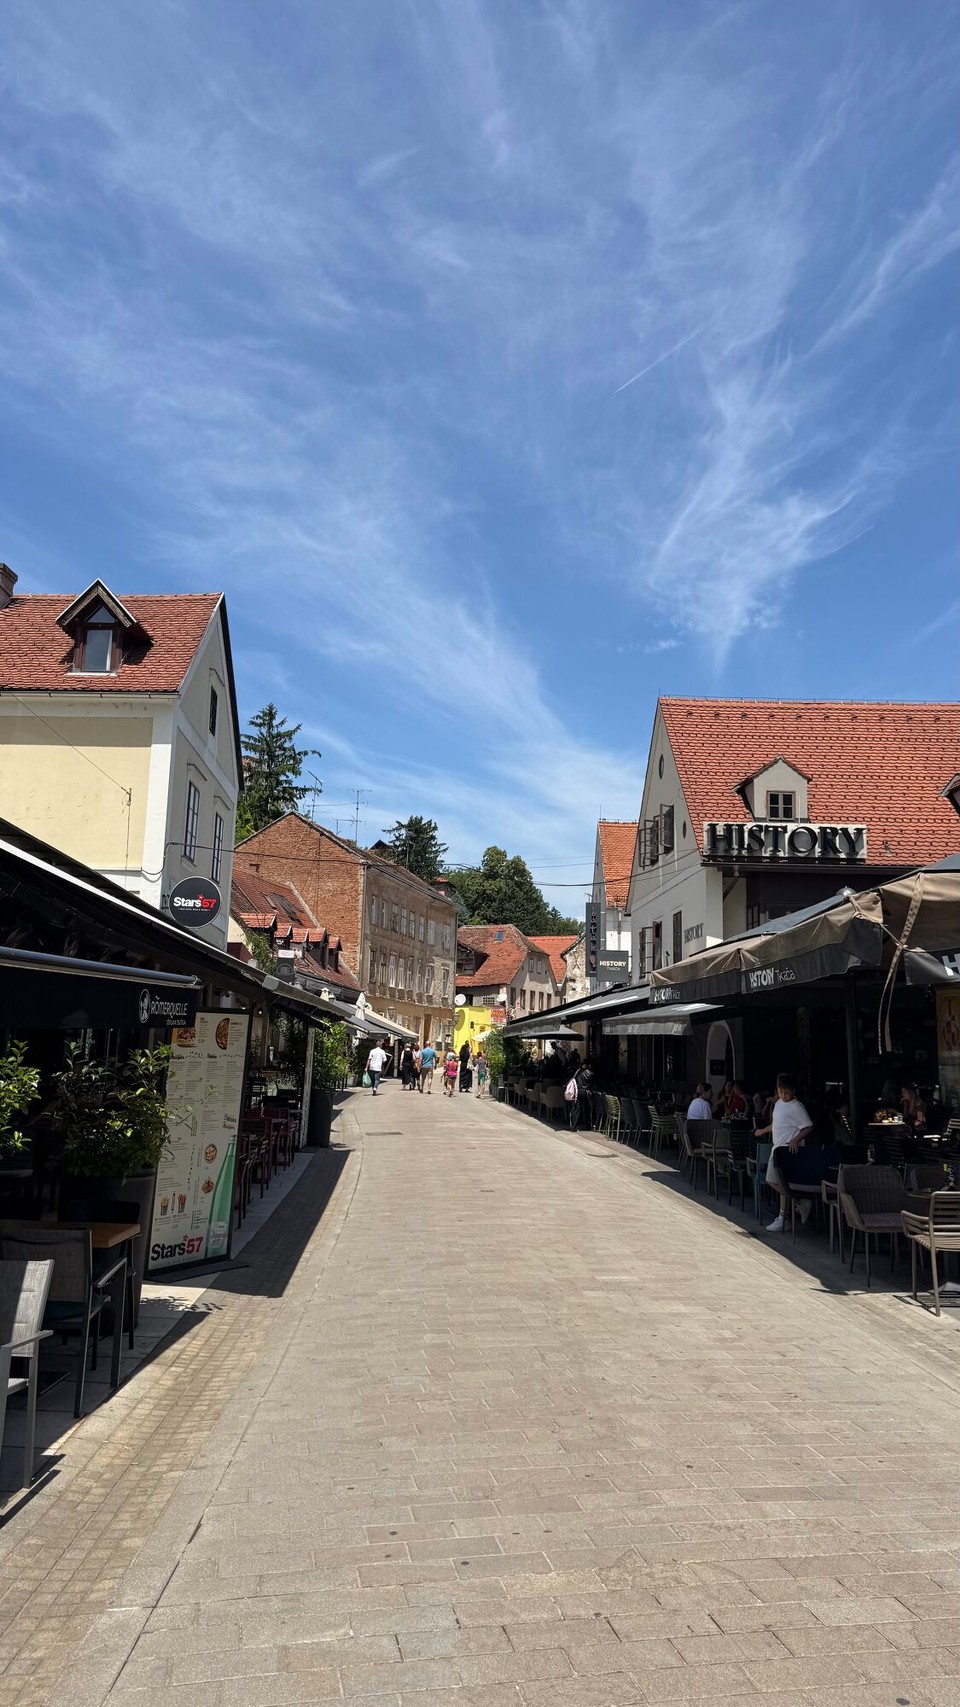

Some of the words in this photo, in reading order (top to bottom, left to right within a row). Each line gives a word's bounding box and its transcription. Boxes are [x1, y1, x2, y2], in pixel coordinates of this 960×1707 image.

[706, 823, 868, 856] HISTORY
[173, 896, 201, 908] Stars
[151, 1242, 186, 1261] Stars
[186, 1236, 204, 1255] 57
